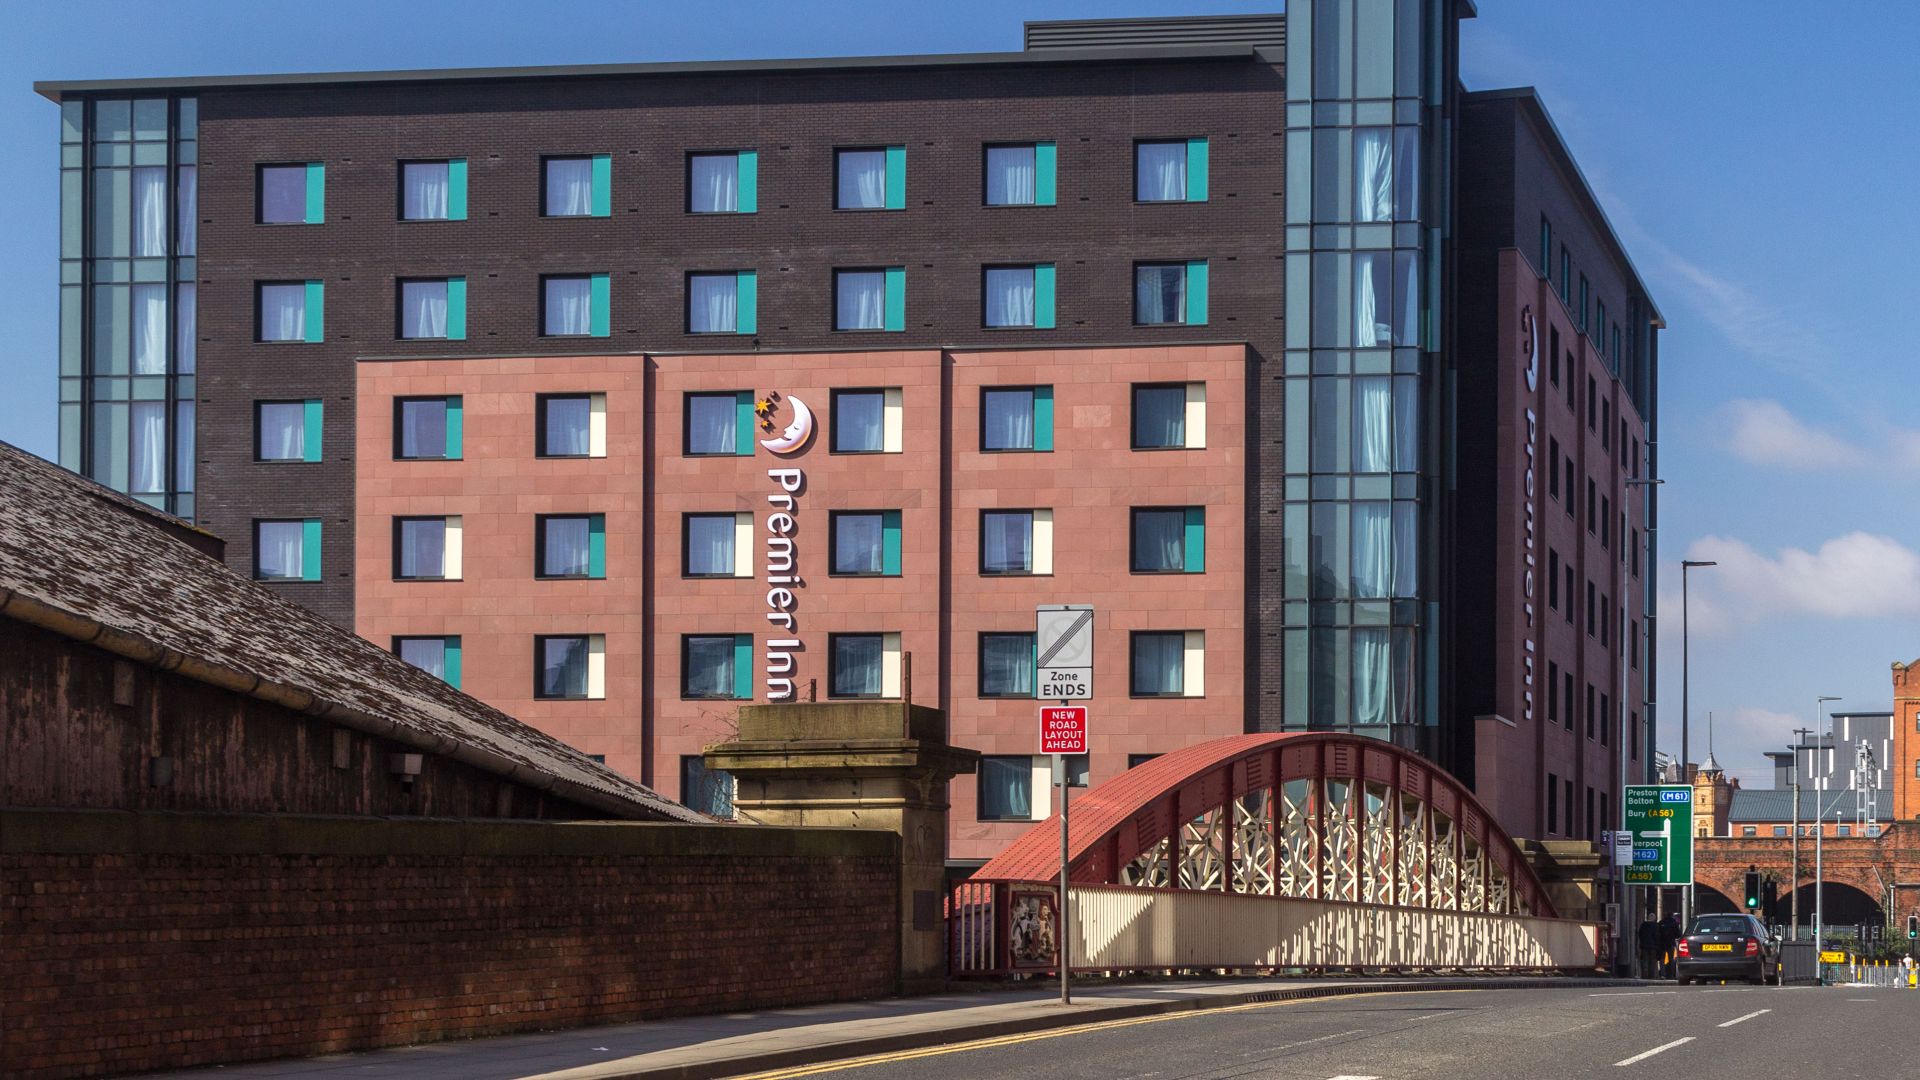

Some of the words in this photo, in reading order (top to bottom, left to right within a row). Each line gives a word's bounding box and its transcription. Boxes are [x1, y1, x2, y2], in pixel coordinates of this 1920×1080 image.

[1526, 408, 1536, 627] Premier
[767, 468, 802, 629] Premier
[766, 639, 800, 699] Inn
[1051, 672, 1078, 681] Zone
[1525, 639, 1534, 720] Inn
[1043, 684, 1086, 696] ENDS
[1052, 711, 1075, 719] NEW
[1050, 721, 1077, 729] ROAD
[1045, 731, 1082, 739] LAYOUT
[1046, 741, 1081, 749] AHEAD
[1628, 797, 1654, 805] Bolton
[1628, 810, 1646, 818] Bury
[1634, 840, 1663, 848] verpool
[1628, 864, 1664, 872] Stretford
